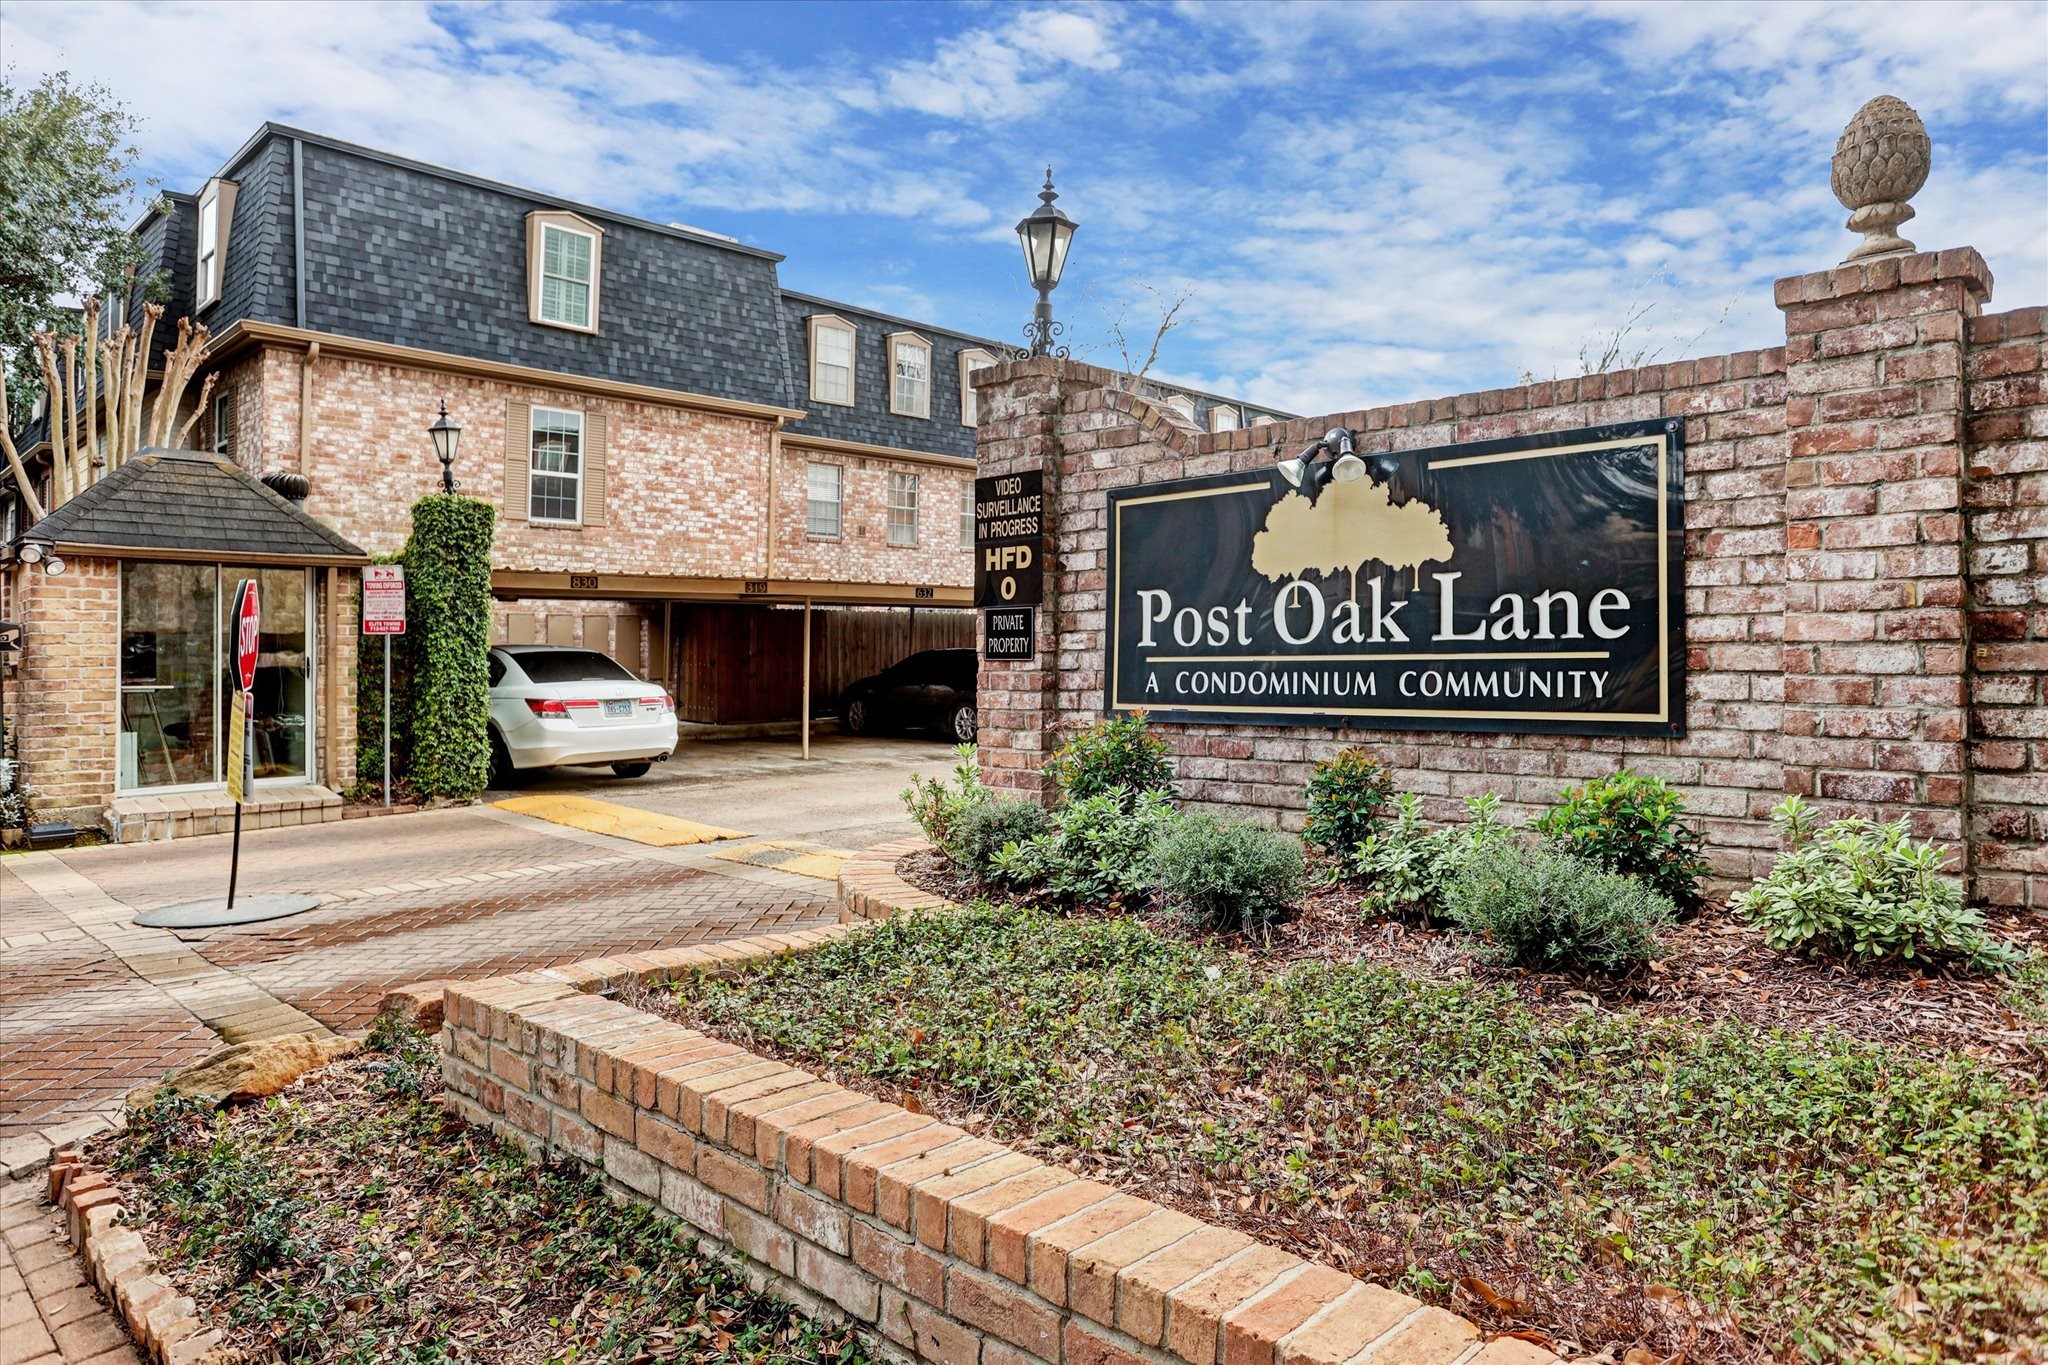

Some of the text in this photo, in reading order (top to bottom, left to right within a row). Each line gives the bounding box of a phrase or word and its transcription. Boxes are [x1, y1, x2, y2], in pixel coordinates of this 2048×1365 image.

[995, 476, 1022, 496] VIDEO
[976, 495, 1041, 520] SURVEILLANCE
[979, 517, 1039, 539] IN PROGRESS
[985, 545, 1033, 572] HFD
[572, 576, 597, 588] 830
[747, 582, 766, 593] 319
[916, 588, 932, 598] 632
[1136, 570, 1632, 648] Post Oak Lane
[992, 614, 1024, 630] PRIVATE
[240, 615, 258, 657] STOP
[988, 637, 1030, 653] PROPERTY
[1144, 669, 1611, 699] A CONDOMINIUM COMMUNITY
